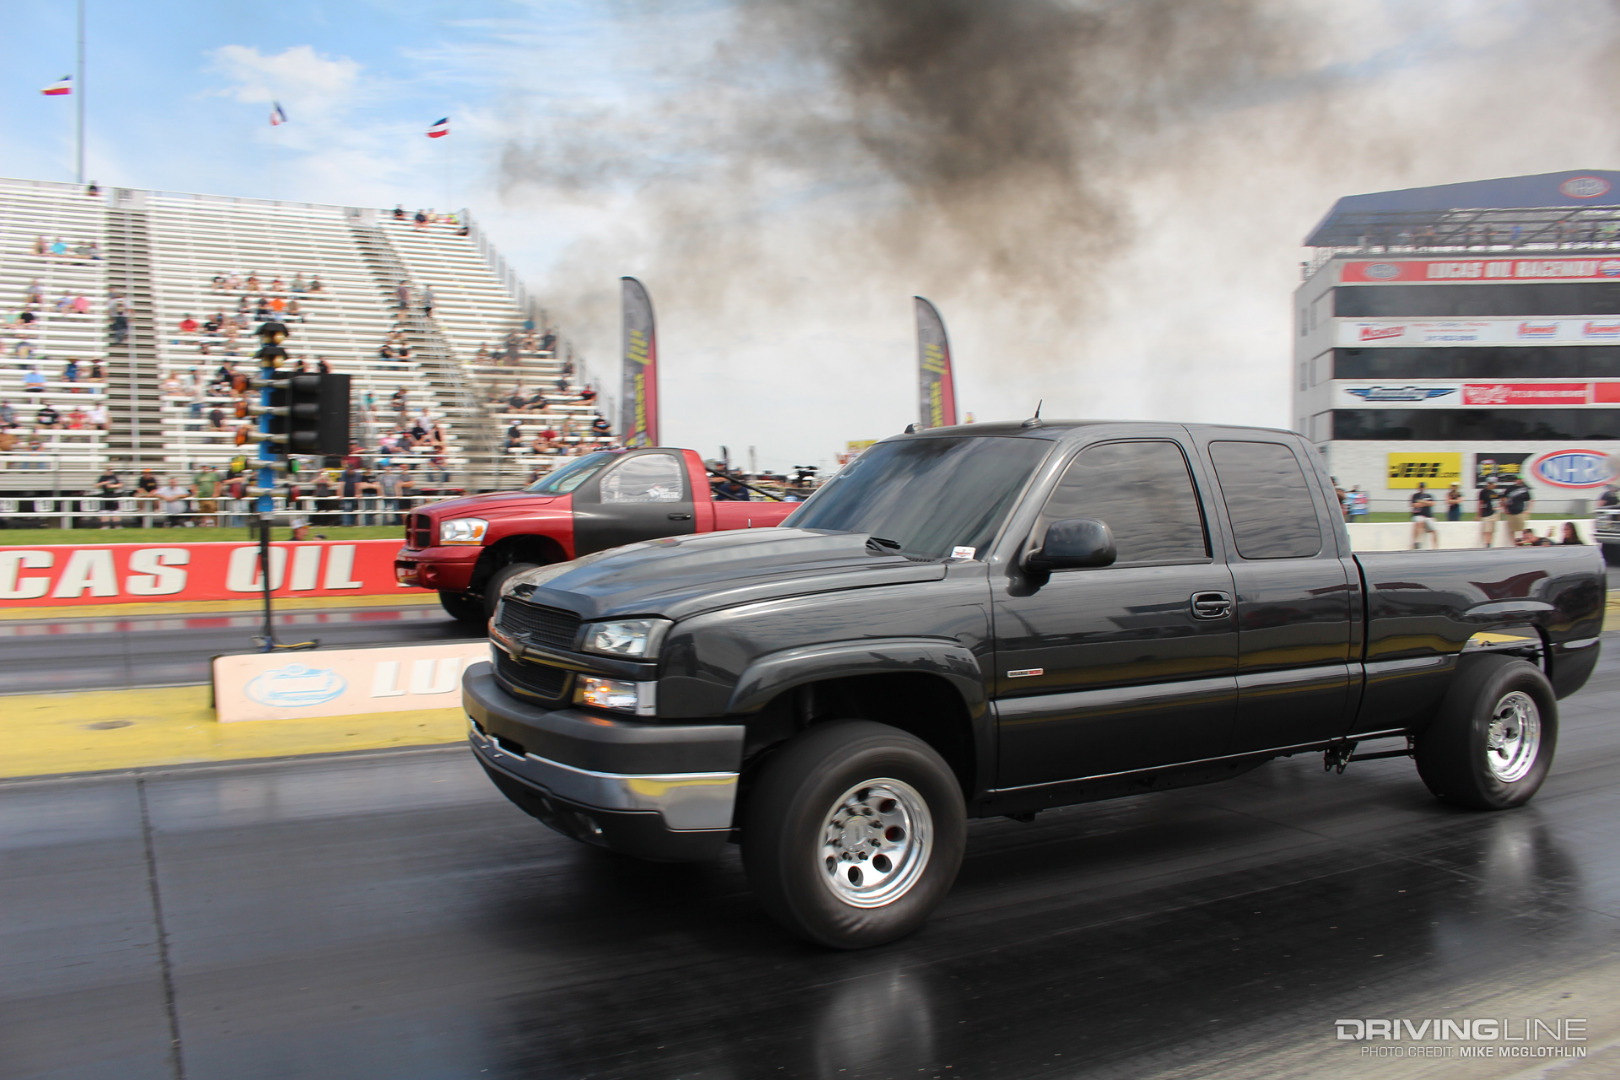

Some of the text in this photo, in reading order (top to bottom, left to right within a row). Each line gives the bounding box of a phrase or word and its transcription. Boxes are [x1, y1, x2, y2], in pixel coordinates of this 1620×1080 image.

[1427, 263, 1482, 278] LUCAS
[1485, 262, 1513, 277] OIL
[1516, 261, 1600, 277] RACEWAY
[226, 545, 363, 592] OIL
[371, 656, 490, 698] LU
